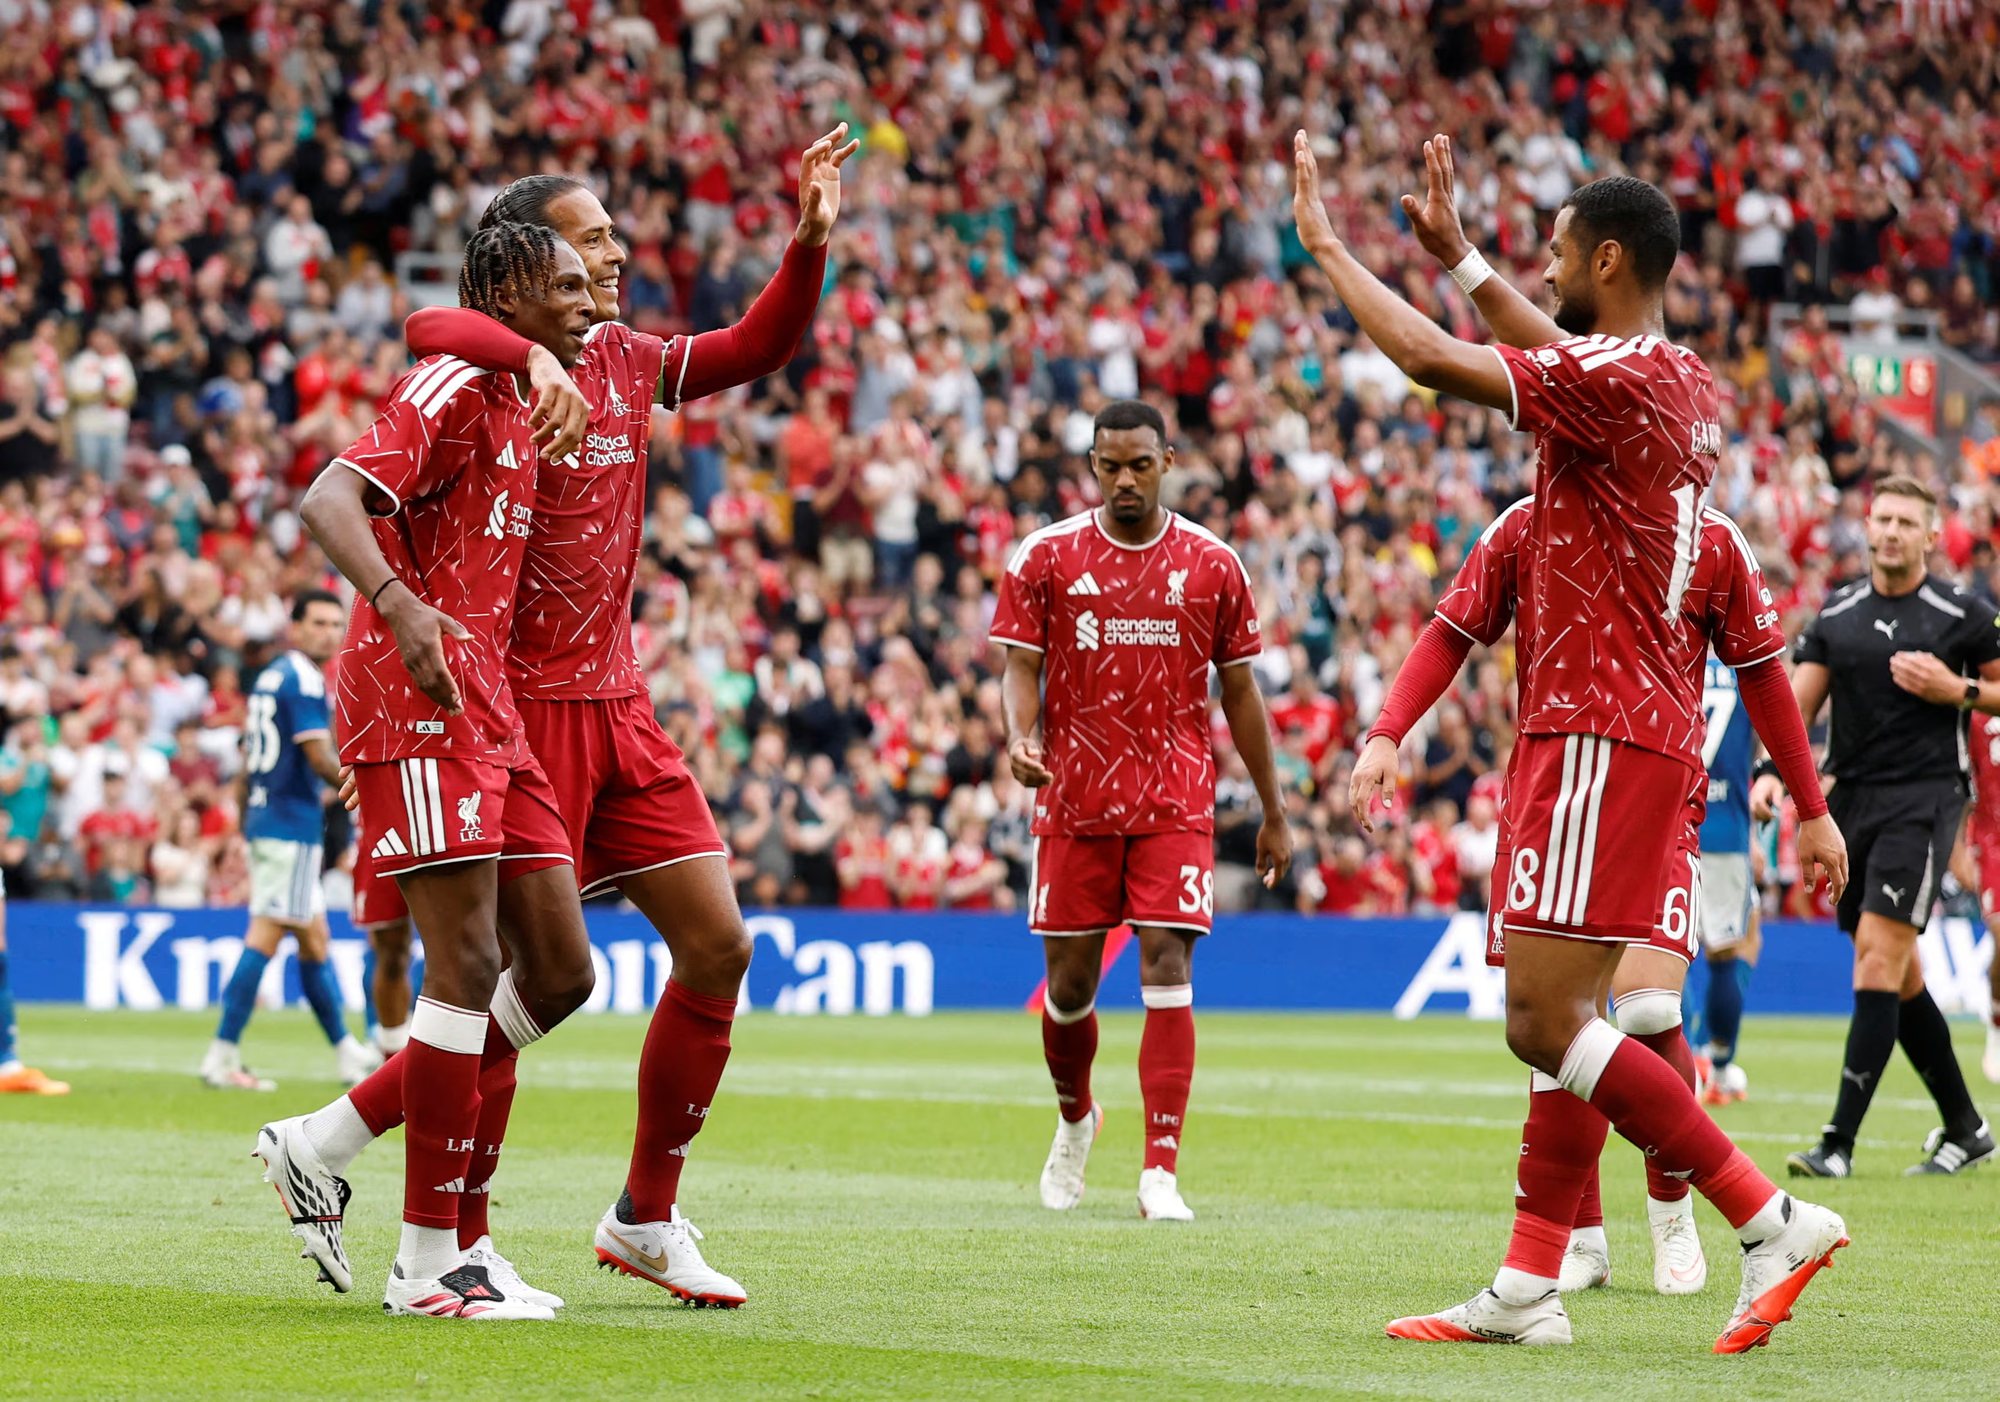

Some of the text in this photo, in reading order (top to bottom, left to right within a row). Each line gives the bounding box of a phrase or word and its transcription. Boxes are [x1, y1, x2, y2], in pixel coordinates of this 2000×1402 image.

[1103, 617, 1177, 633] standard
[1103, 631, 1180, 647] chartered
[1178, 864, 1215, 920] 38
[1661, 886, 1689, 940] 6
[1468, 1323, 1516, 1341] ULTRA
